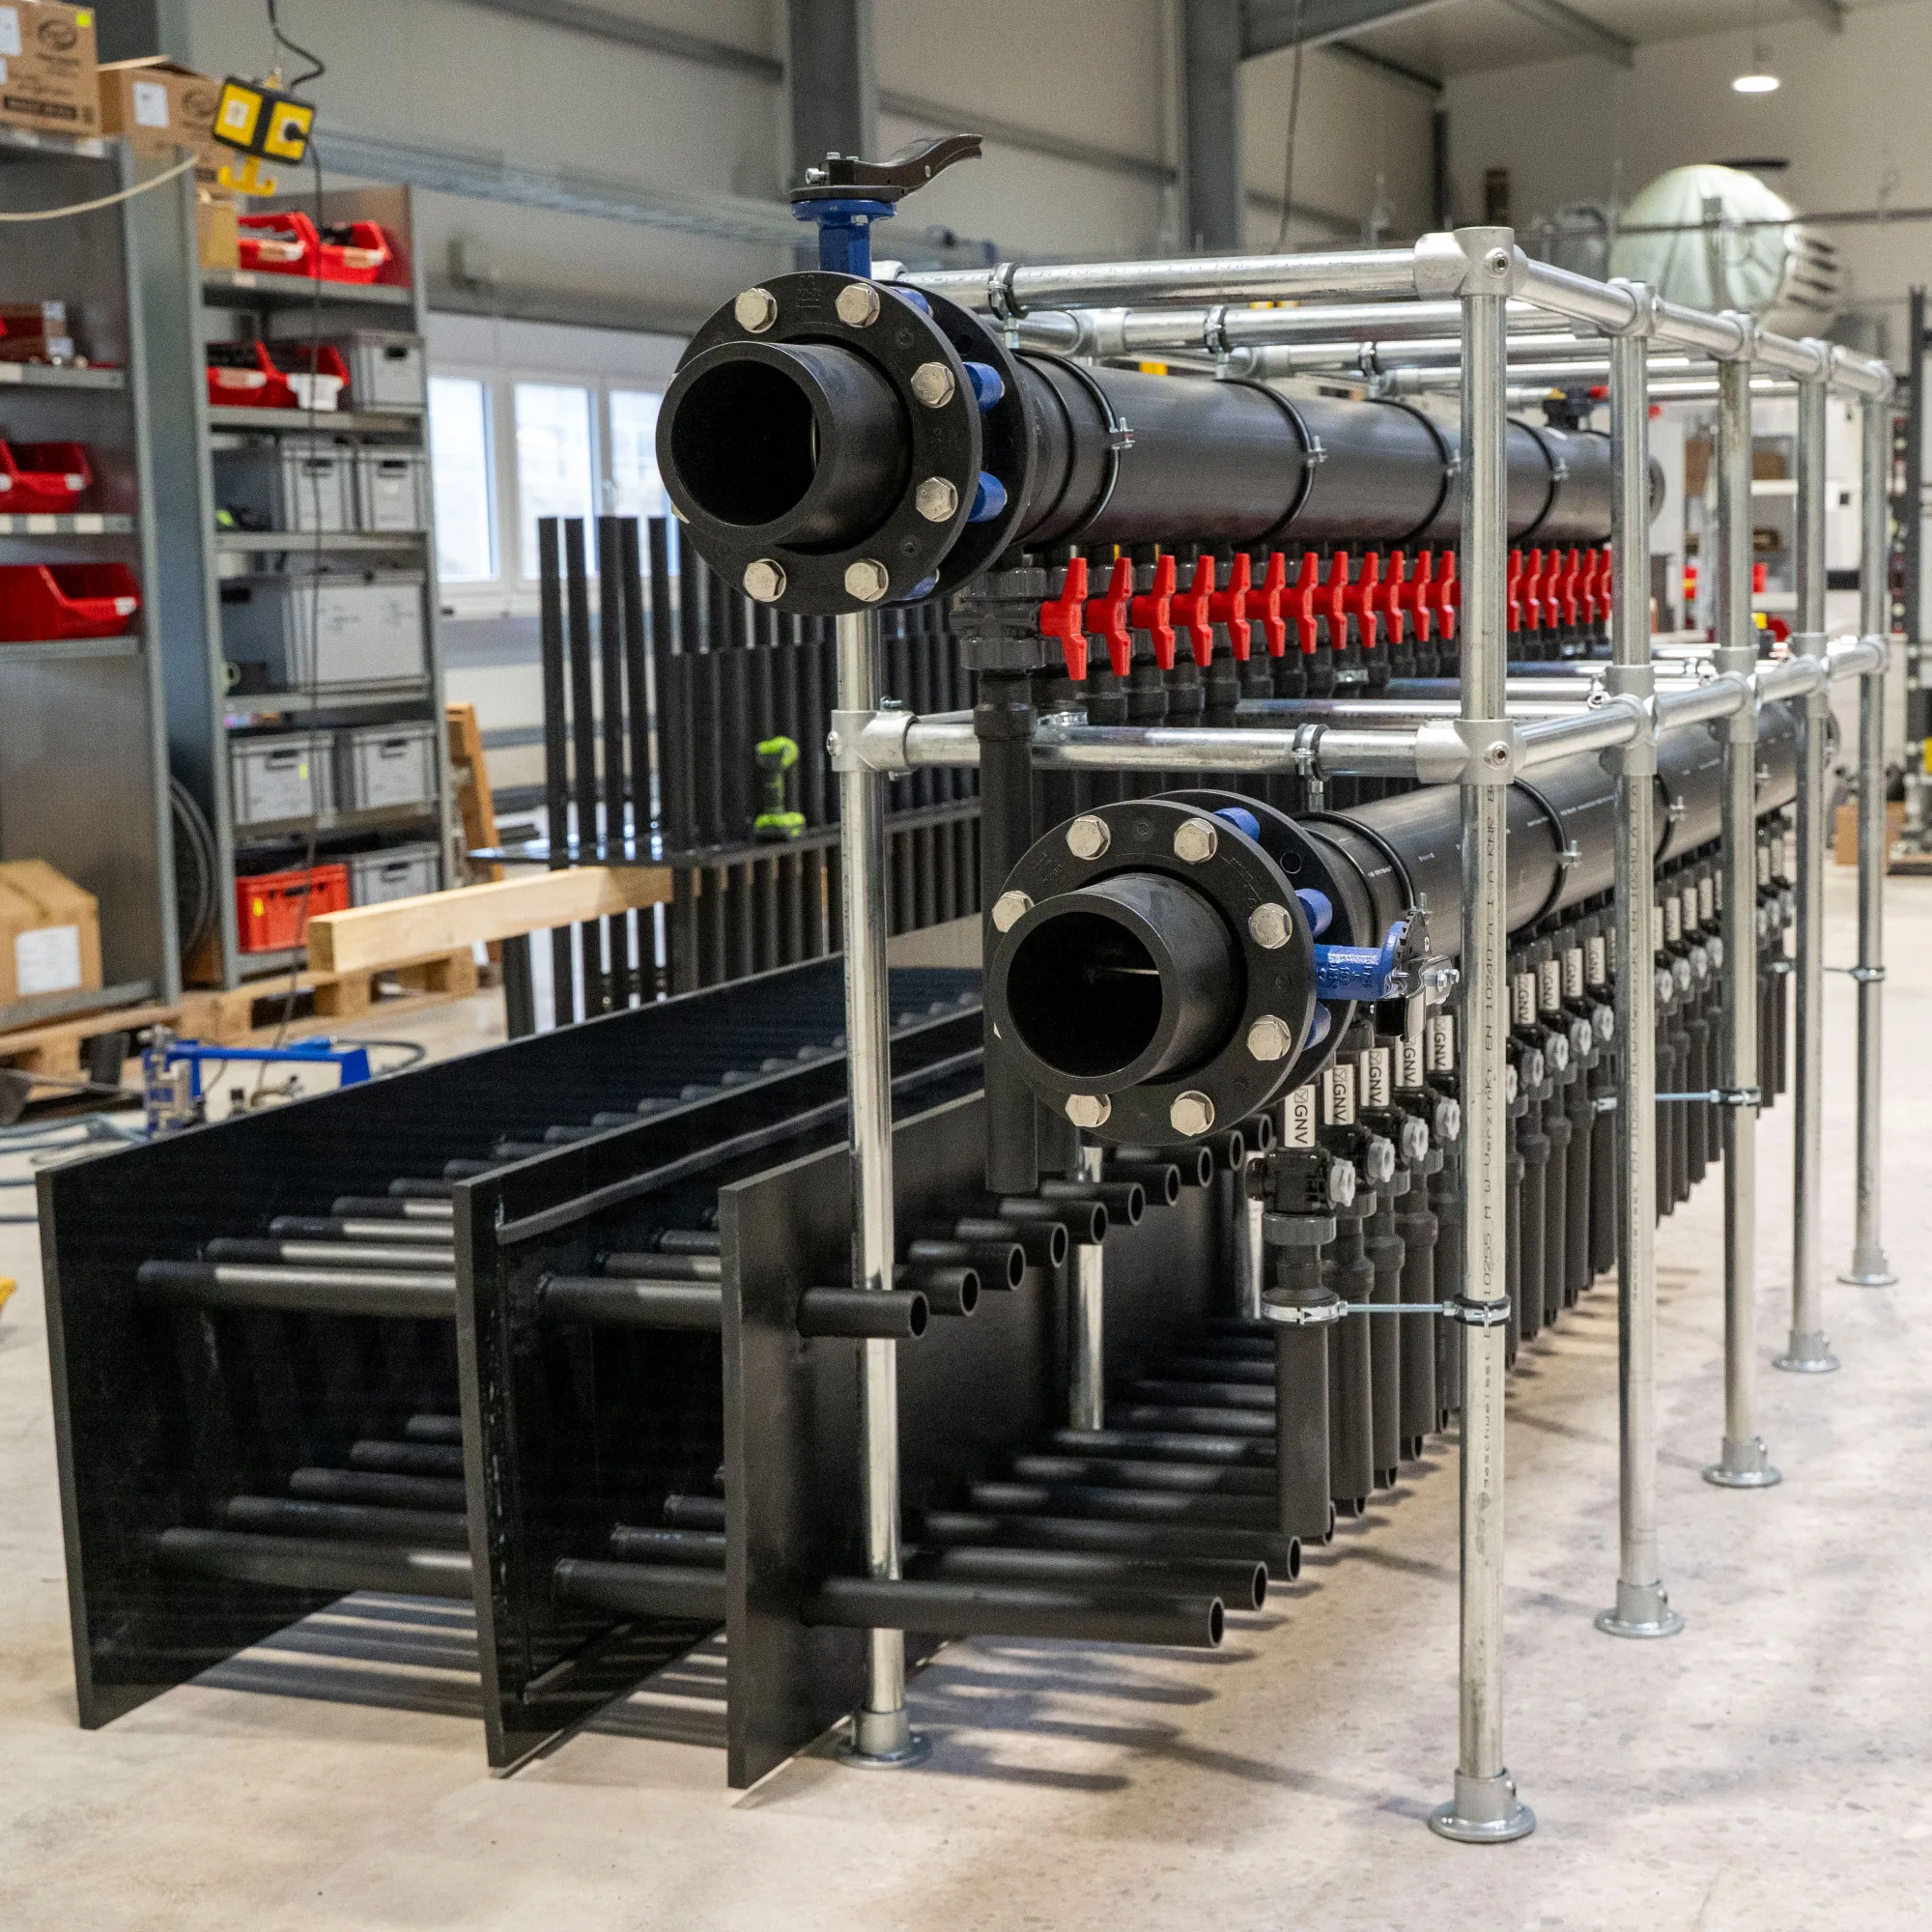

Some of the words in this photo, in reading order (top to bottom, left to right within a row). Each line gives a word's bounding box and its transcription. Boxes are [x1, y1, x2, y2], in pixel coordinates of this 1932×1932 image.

[1519, 990, 1530, 1021] GNV
[1434, 1032, 1446, 1067] GNV
[1485, 1025, 1492, 1051] EN
[1404, 1047, 1416, 1083] GNV
[1369, 1066, 1382, 1103] GNV
[1333, 1083, 1347, 1122] GNV
[1294, 1104, 1308, 1145] GNV
[1484, 1206, 1492, 1220] M
